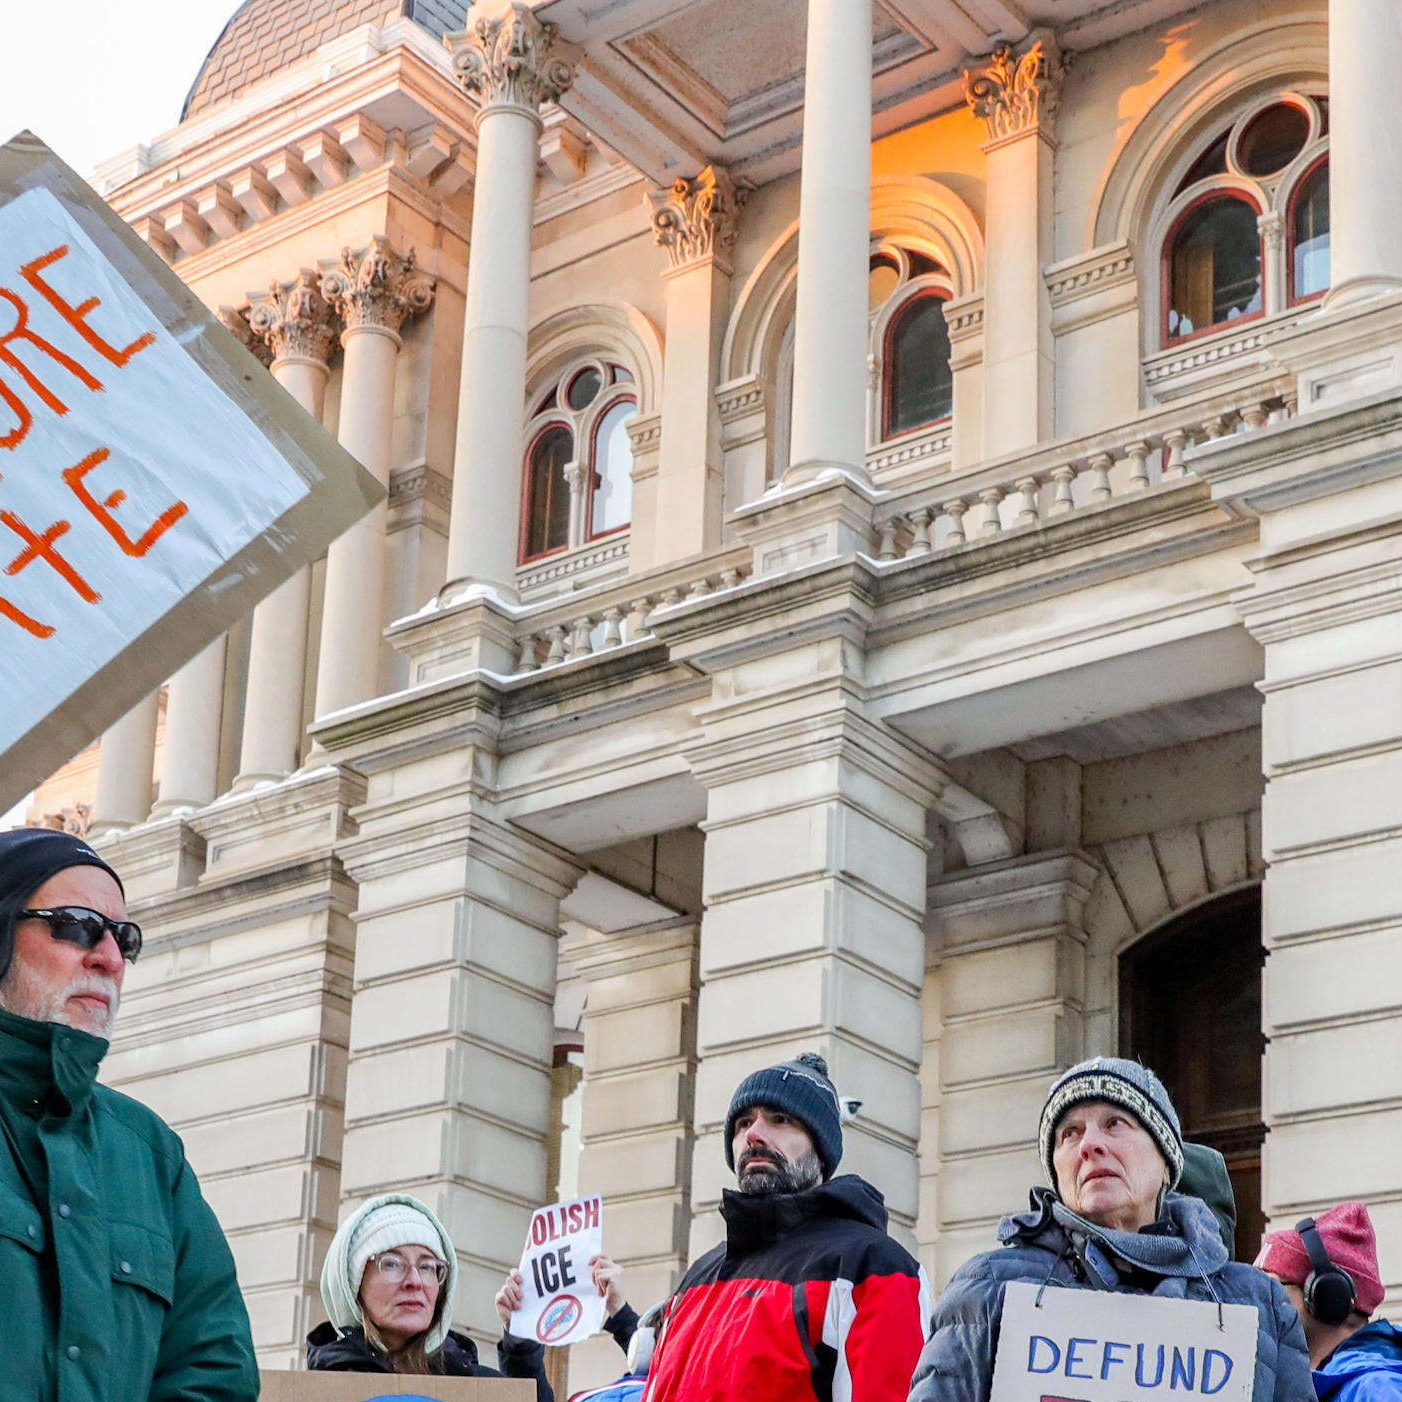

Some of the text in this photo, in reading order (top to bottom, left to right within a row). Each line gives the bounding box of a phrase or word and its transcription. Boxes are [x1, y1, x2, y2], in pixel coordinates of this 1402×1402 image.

[526, 1198, 599, 1250] OLISH
[531, 1245, 576, 1298] ICE
[1027, 1335, 1234, 1394] DEFUND
